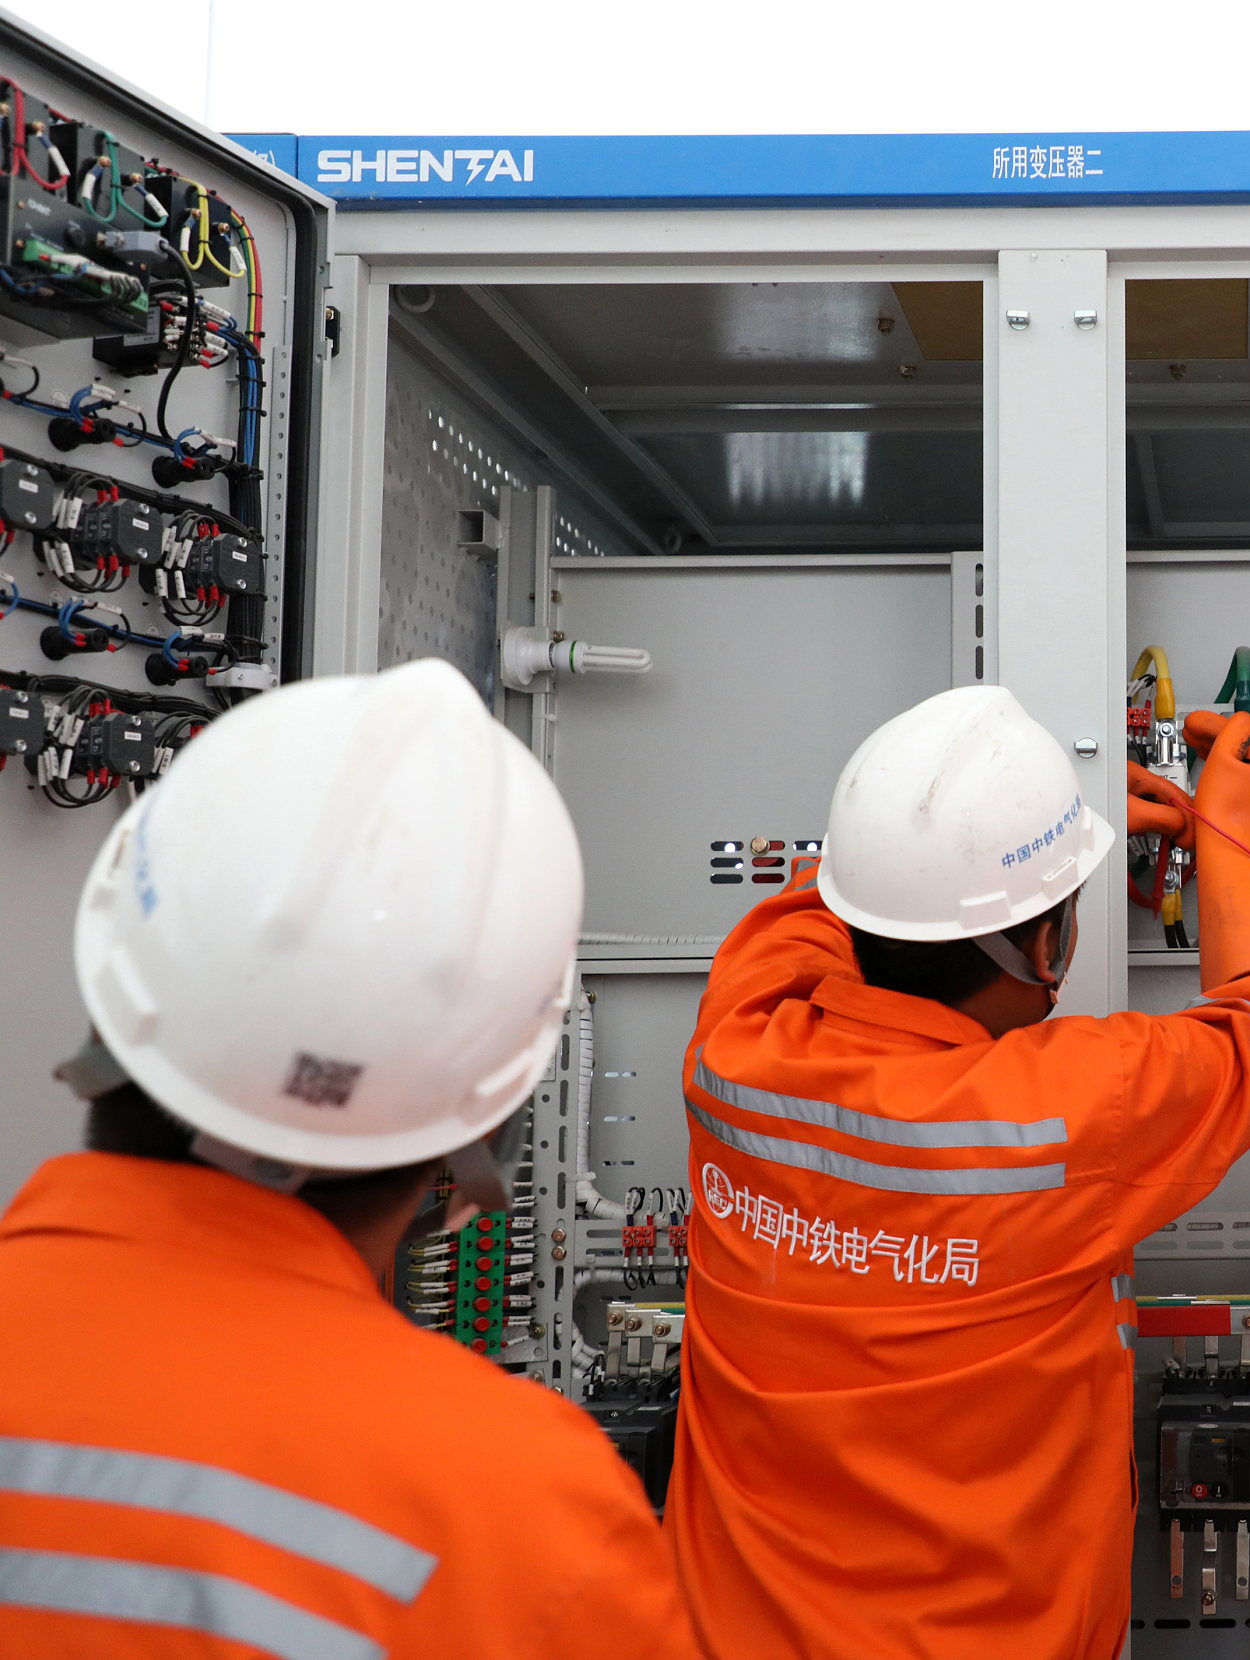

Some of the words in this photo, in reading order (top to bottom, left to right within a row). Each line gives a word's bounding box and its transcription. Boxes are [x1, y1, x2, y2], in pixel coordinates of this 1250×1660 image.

[317, 149, 534, 186] SHENTAI
[992, 145, 1104, 179] 所用变压器二
[1001, 793, 1082, 868] 中国中铁电气化局
[734, 1185, 980, 1286] 中国中铁电气化局
